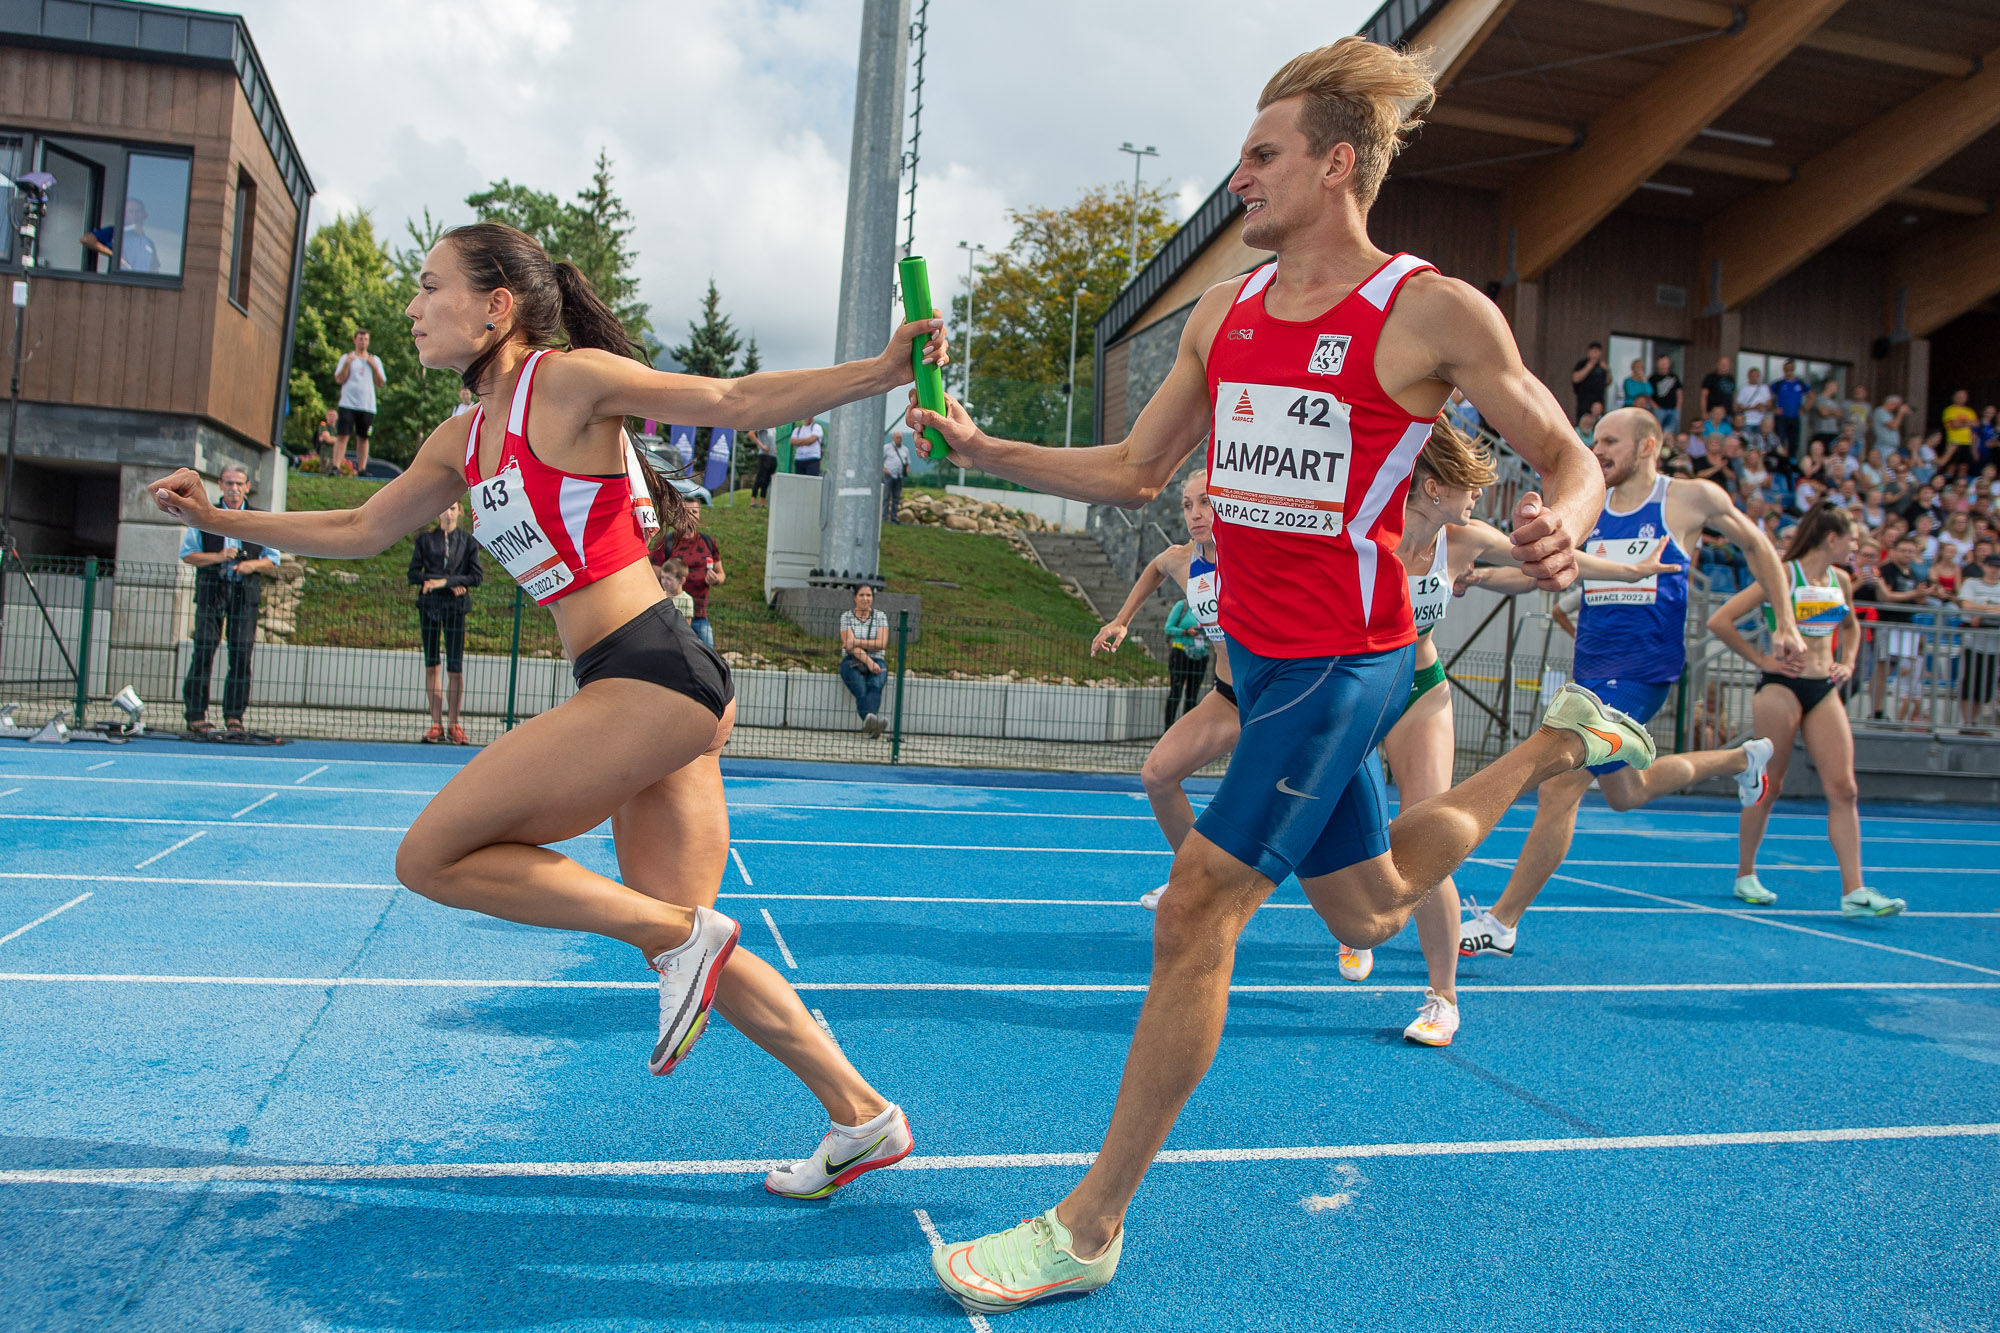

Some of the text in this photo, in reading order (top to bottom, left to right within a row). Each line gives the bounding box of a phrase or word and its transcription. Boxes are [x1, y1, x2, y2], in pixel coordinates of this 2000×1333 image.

[1231, 415, 1254, 423] KARPACZ
[1287, 395, 1331, 428] 42
[1216, 440, 1344, 483] LAMPART
[482, 480, 509, 512] 43
[1274, 511, 1318, 529] 2022
[1627, 541, 1648, 555] 67
[534, 576, 554, 594] 2022
[1417, 576, 1440, 595] 19
[1621, 593, 1643, 602] 2022
